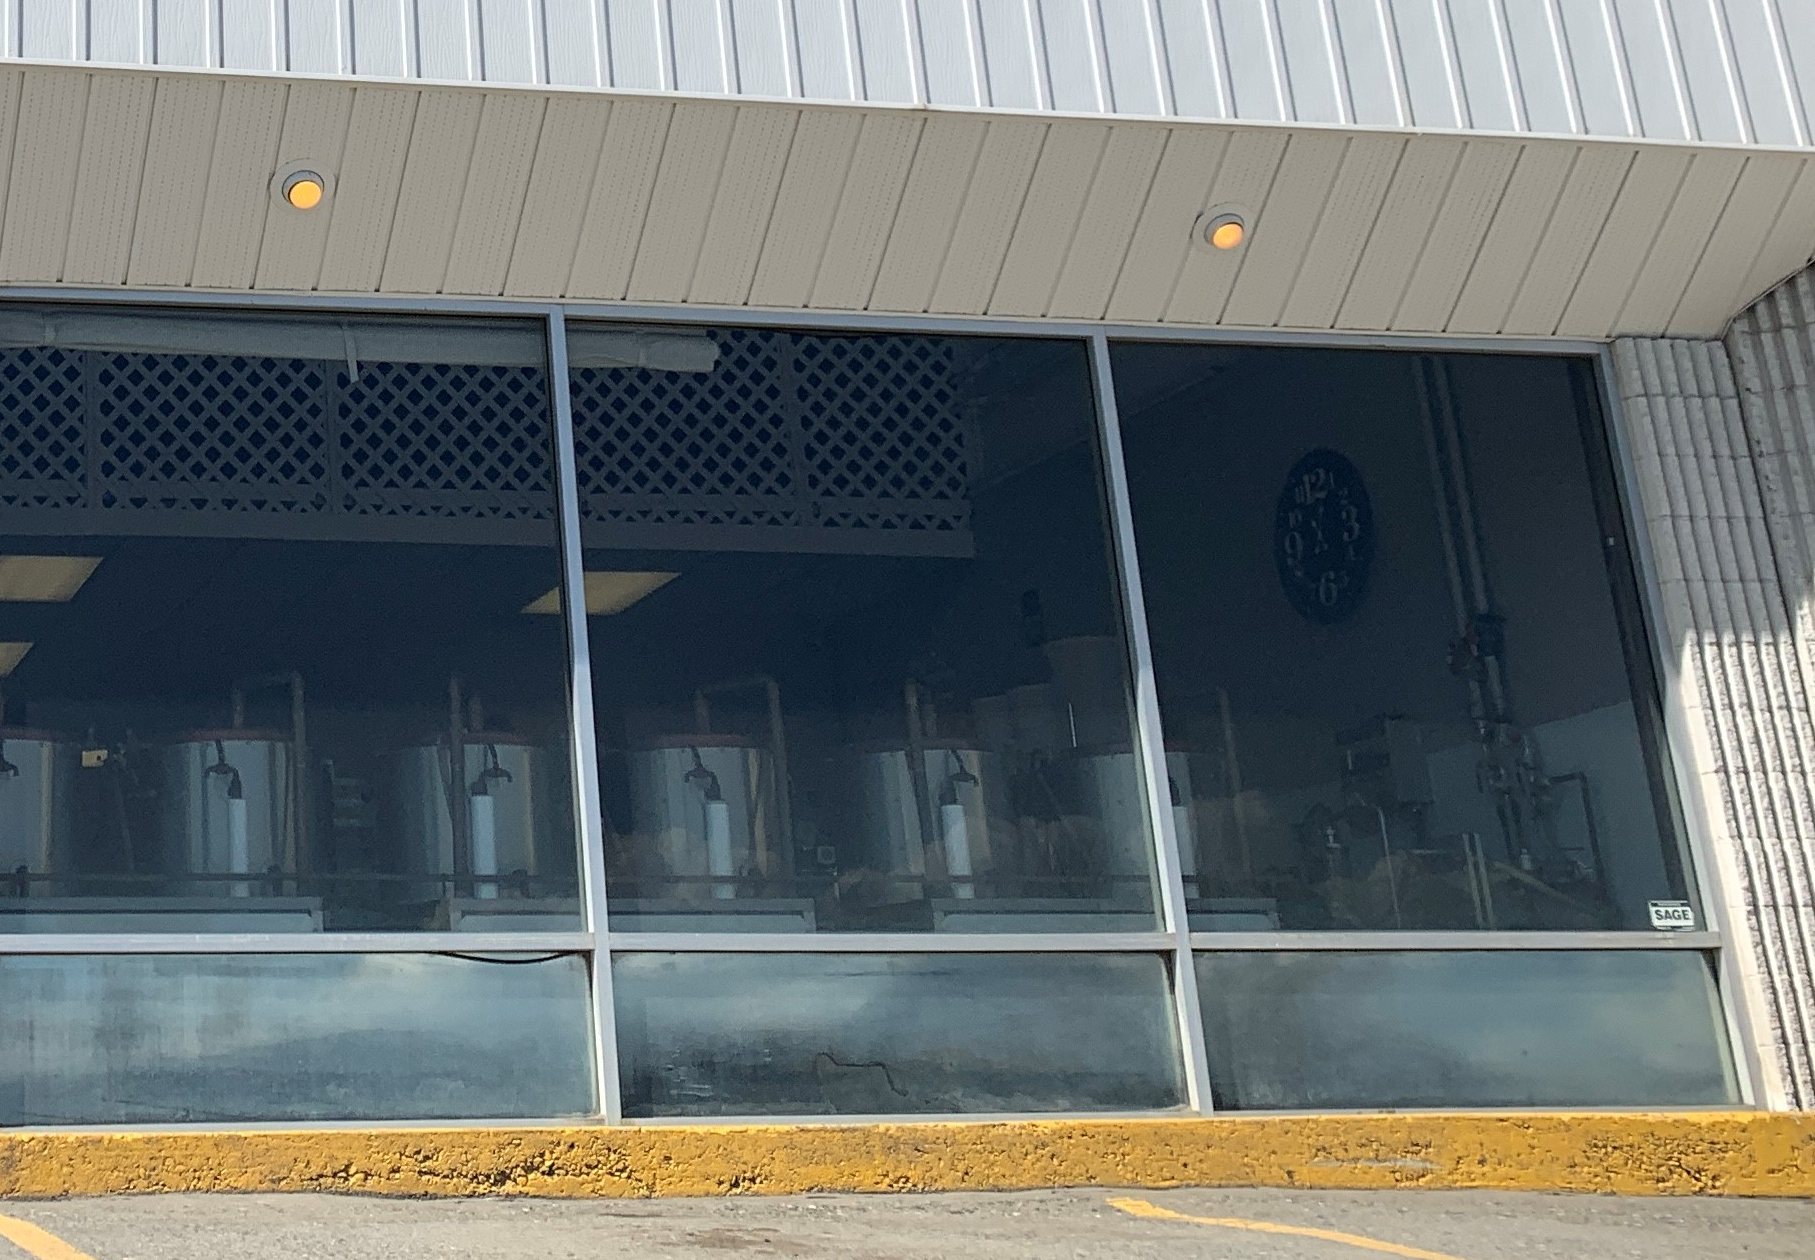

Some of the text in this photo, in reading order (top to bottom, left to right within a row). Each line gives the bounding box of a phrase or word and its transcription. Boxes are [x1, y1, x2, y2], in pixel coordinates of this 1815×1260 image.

[1301, 467, 1328, 506] 12
[1340, 504, 1361, 543] 3
[1283, 530, 1304, 566] 9
[1318, 570, 1339, 607] 6
[1654, 909, 1692, 921] SAGE
